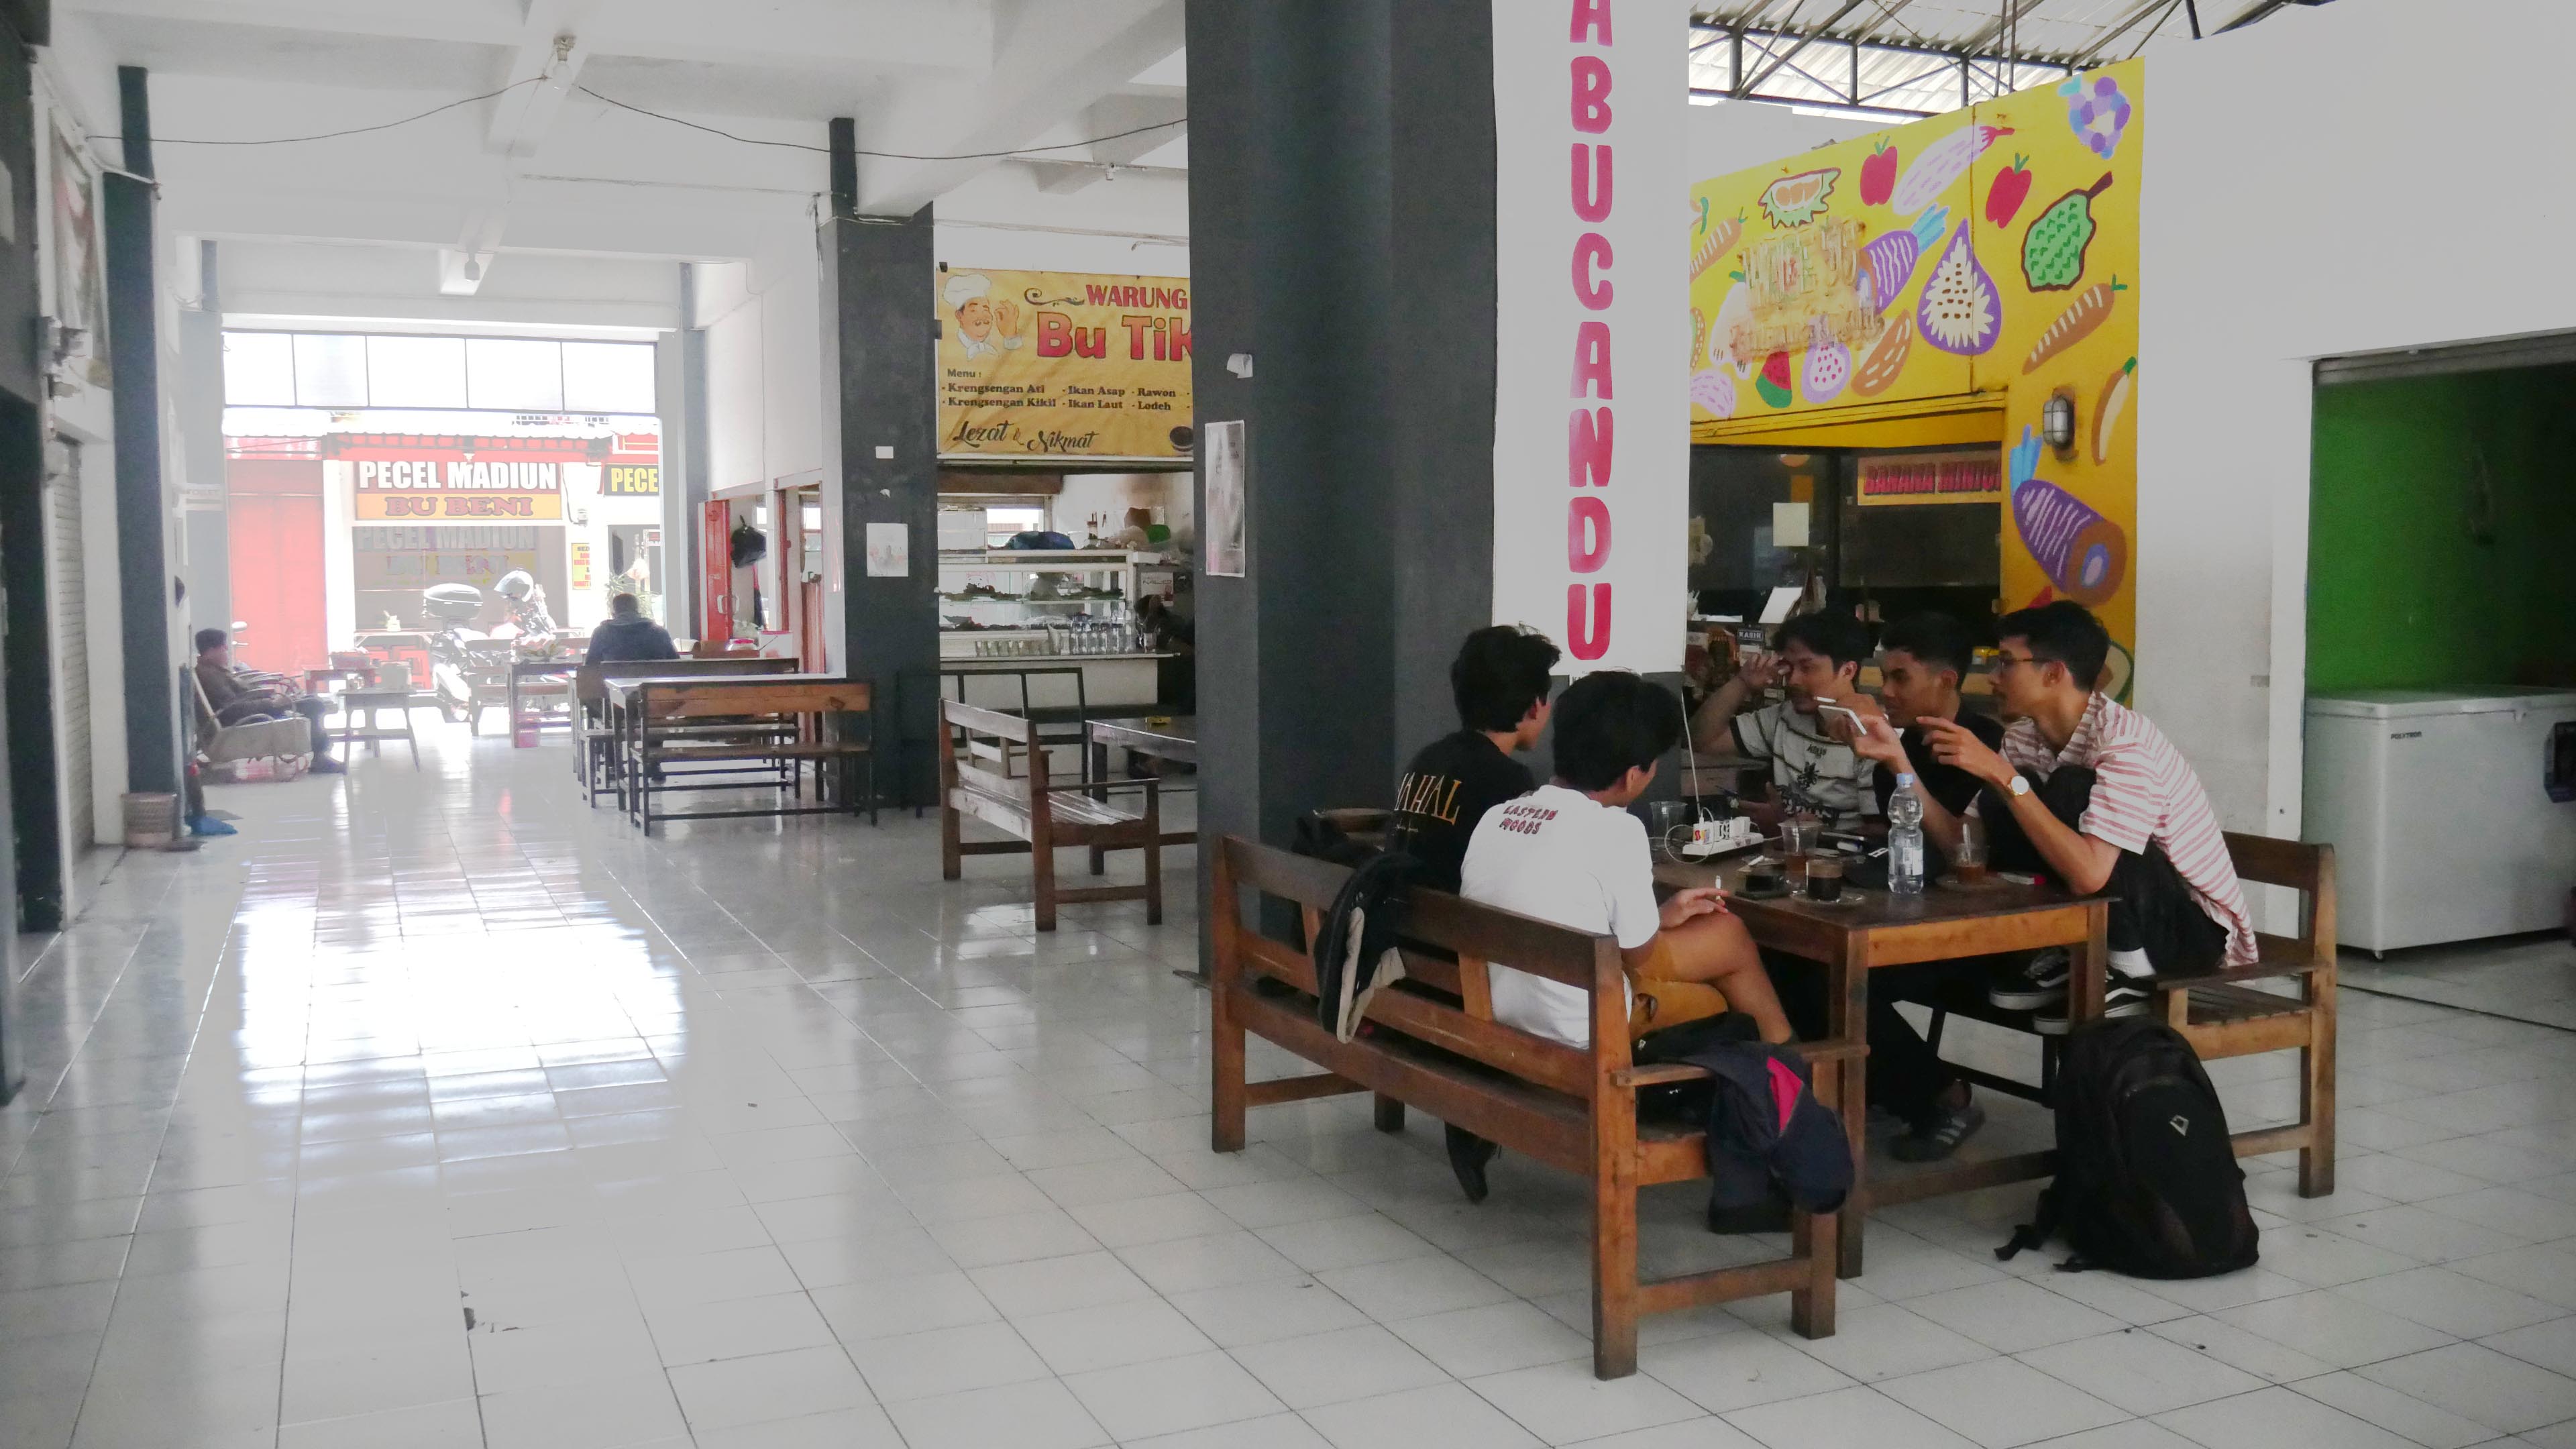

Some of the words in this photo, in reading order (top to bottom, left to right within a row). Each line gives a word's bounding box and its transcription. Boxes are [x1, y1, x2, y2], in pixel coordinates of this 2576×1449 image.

[1085, 284, 1187, 309] WARUNG
[1036, 311, 1106, 359] Bu
[947, 369, 975, 378] Menu
[948, 383, 1024, 394] Krengsengan
[1026, 384, 1045, 393] Ati
[1068, 386, 1095, 395] Ikan
[1097, 386, 1126, 397] Asap
[1137, 388, 1177, 397] Rawon
[948, 397, 1024, 408] Krengsengan
[1026, 398, 1057, 407] Kikil
[1068, 399, 1095, 409] Ikan
[1097, 400, 1123, 409] Laut
[1137, 400, 1171, 411] Lodeh
[953, 420, 1015, 448] Lezat
[1026, 430, 1099, 453] Nikmat
[358, 461, 442, 489] PECEL
[447, 462, 557, 490] MADIUN
[384, 496, 438, 517] BU
[444, 496, 534, 517] BENI
